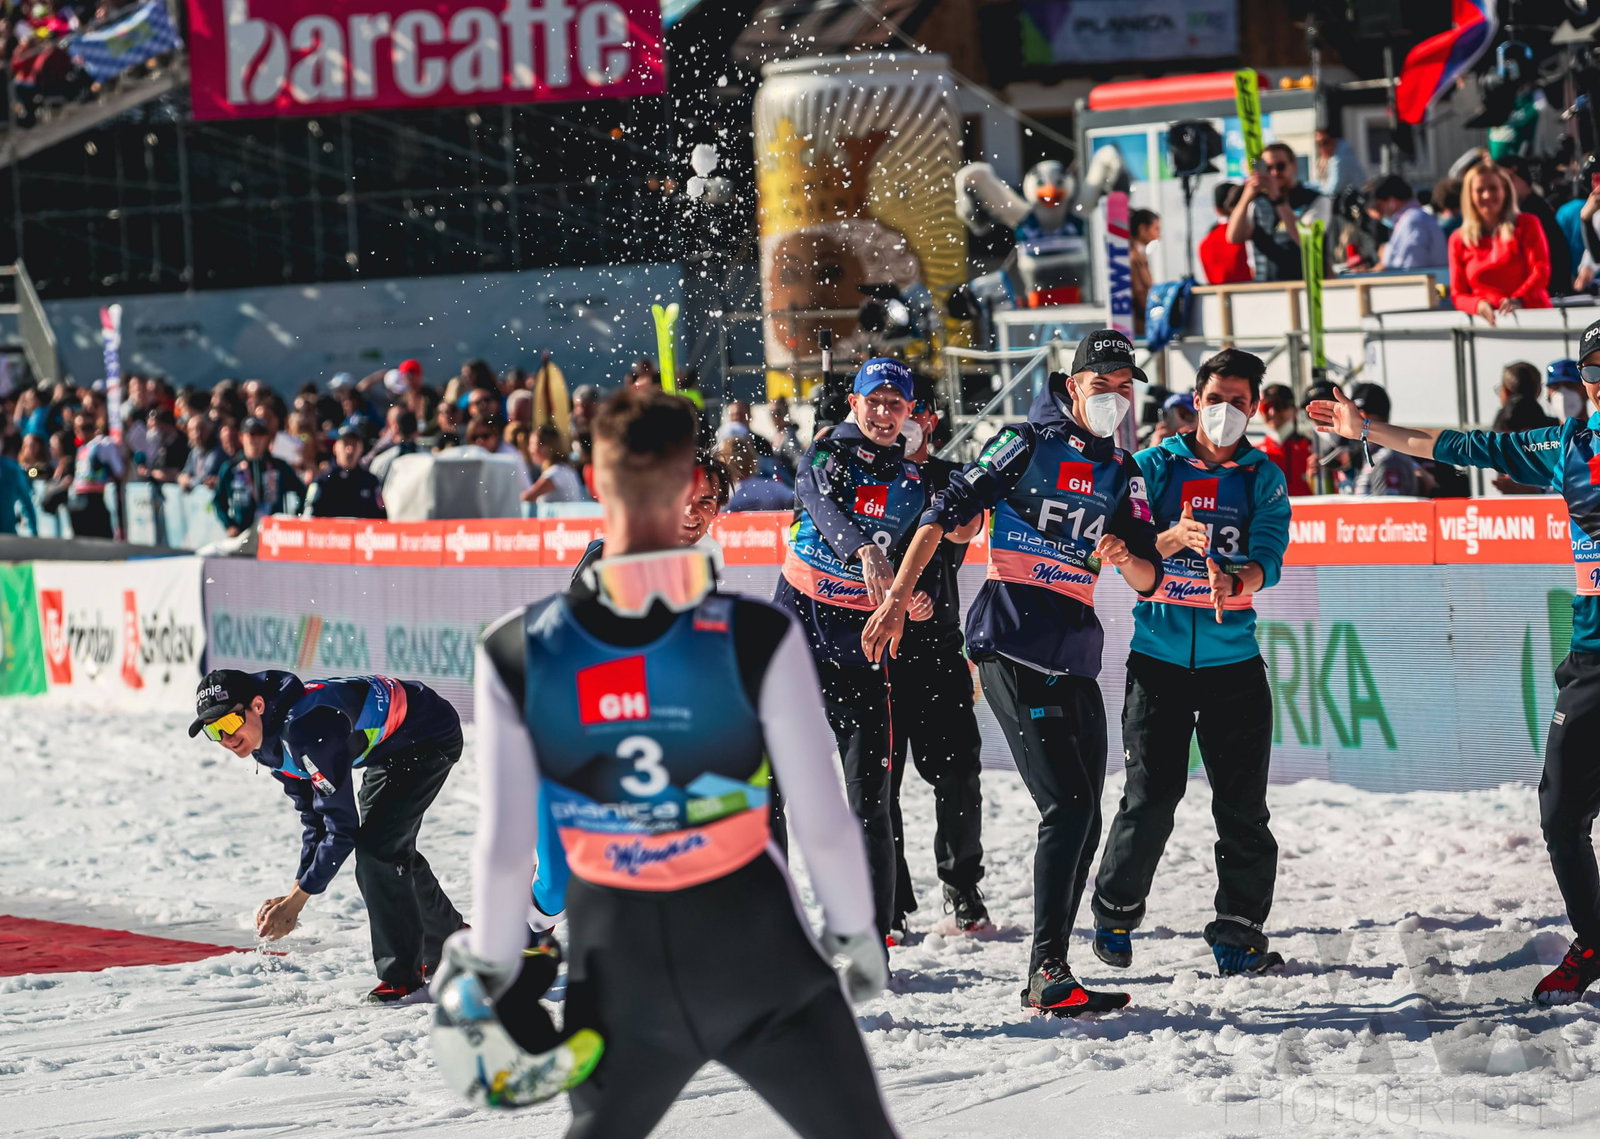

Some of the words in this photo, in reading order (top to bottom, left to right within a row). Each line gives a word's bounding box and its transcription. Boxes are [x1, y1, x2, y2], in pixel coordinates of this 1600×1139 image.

[1108, 242, 1132, 315] BWT
[996, 439, 1026, 468] geoplin
[1068, 477, 1092, 494] GH
[863, 501, 885, 517] GH
[1191, 496, 1215, 509] GH
[1037, 498, 1106, 547] F14
[1378, 516, 1428, 543] climate
[1547, 514, 1566, 540] for
[1007, 530, 1087, 559] planica
[802, 544, 864, 574] planic
[1032, 562, 1094, 586] Manner
[1256, 620, 1398, 750] RKA
[599, 693, 647, 720] GH
[615, 734, 671, 797] 3
